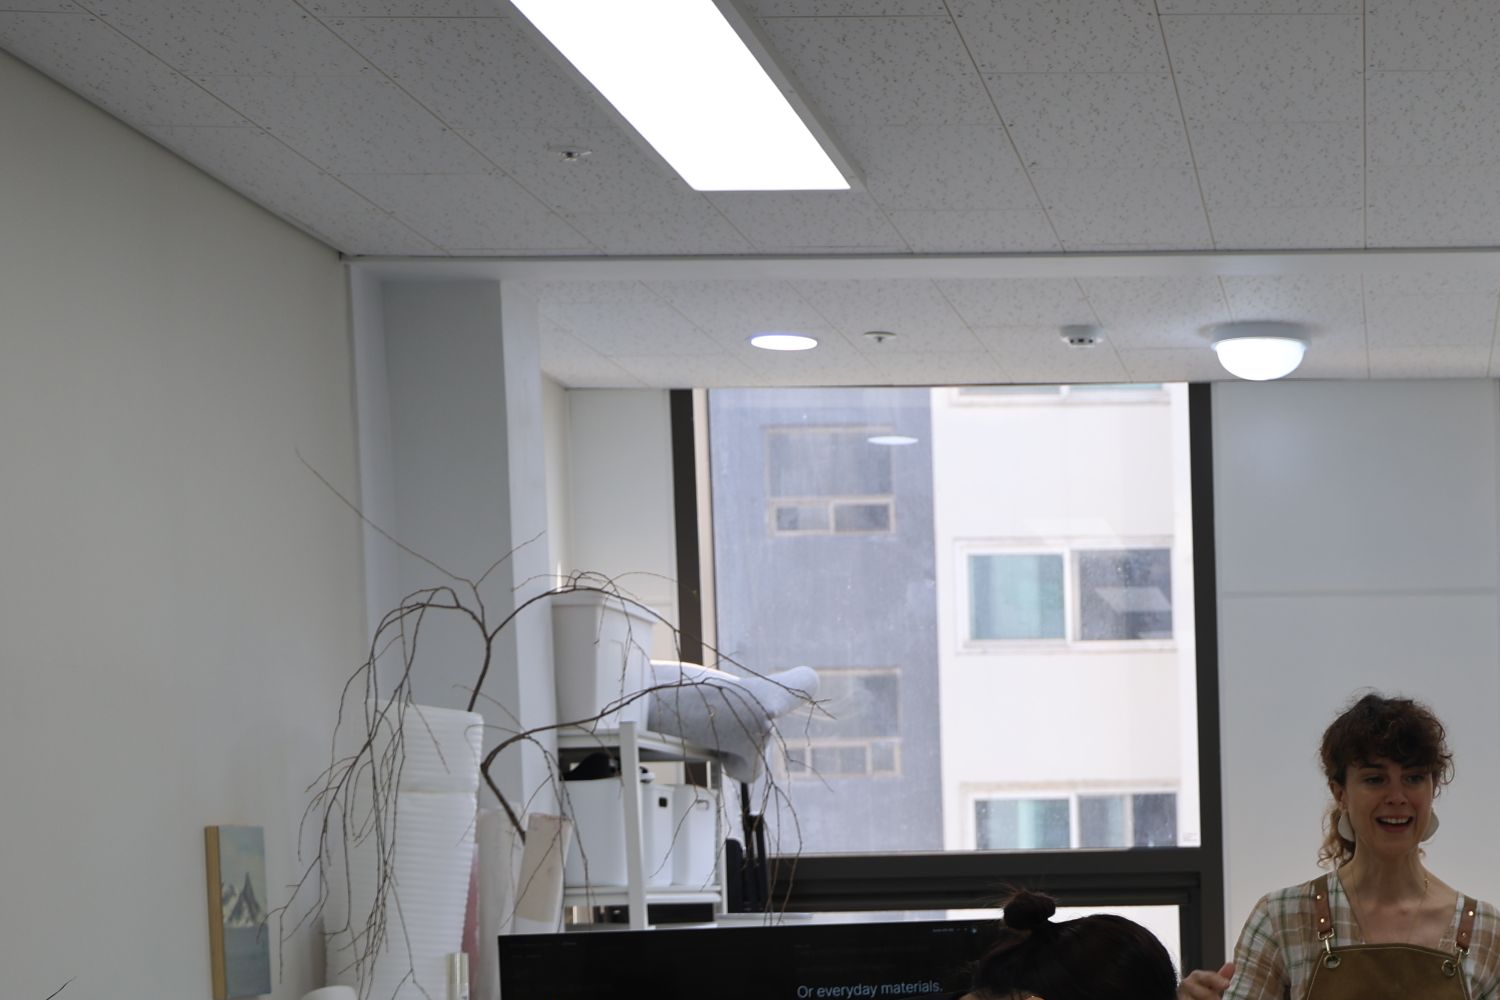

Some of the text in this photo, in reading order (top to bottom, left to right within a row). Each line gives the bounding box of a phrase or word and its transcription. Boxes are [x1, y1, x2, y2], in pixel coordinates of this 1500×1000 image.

[797, 981, 942, 998] Or everyday materials.
